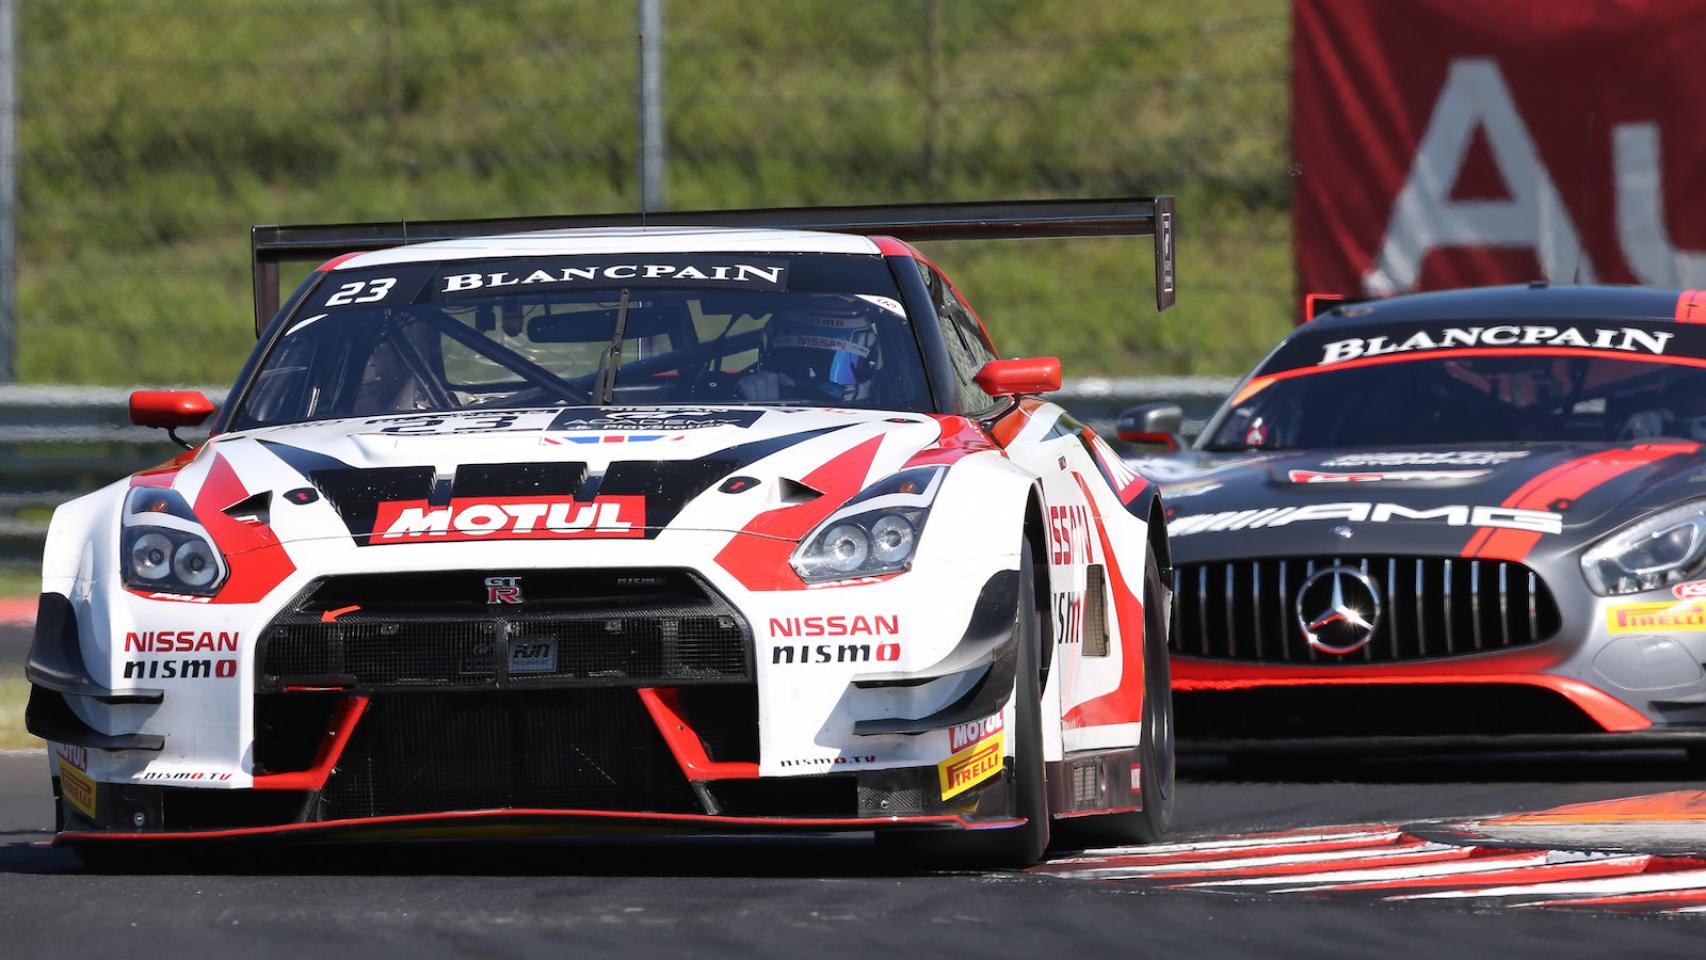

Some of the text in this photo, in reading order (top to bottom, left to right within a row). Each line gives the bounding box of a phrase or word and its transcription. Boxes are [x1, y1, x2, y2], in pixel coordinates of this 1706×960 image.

[325, 278, 397, 306] 23
[441, 264, 784, 292] BLANCPAIN
[1317, 326, 1674, 366] BLANCPAIN
[383, 503, 632, 539] MOTUL
[1268, 503, 1563, 534] AMG
[769, 615, 900, 637] NISSAN
[124, 631, 239, 653] NISSAN
[773, 642, 902, 664] nismo
[124, 658, 237, 680] nismo
[952, 710, 1003, 750] MOTUL
[946, 743, 999, 791] PIRELLI
